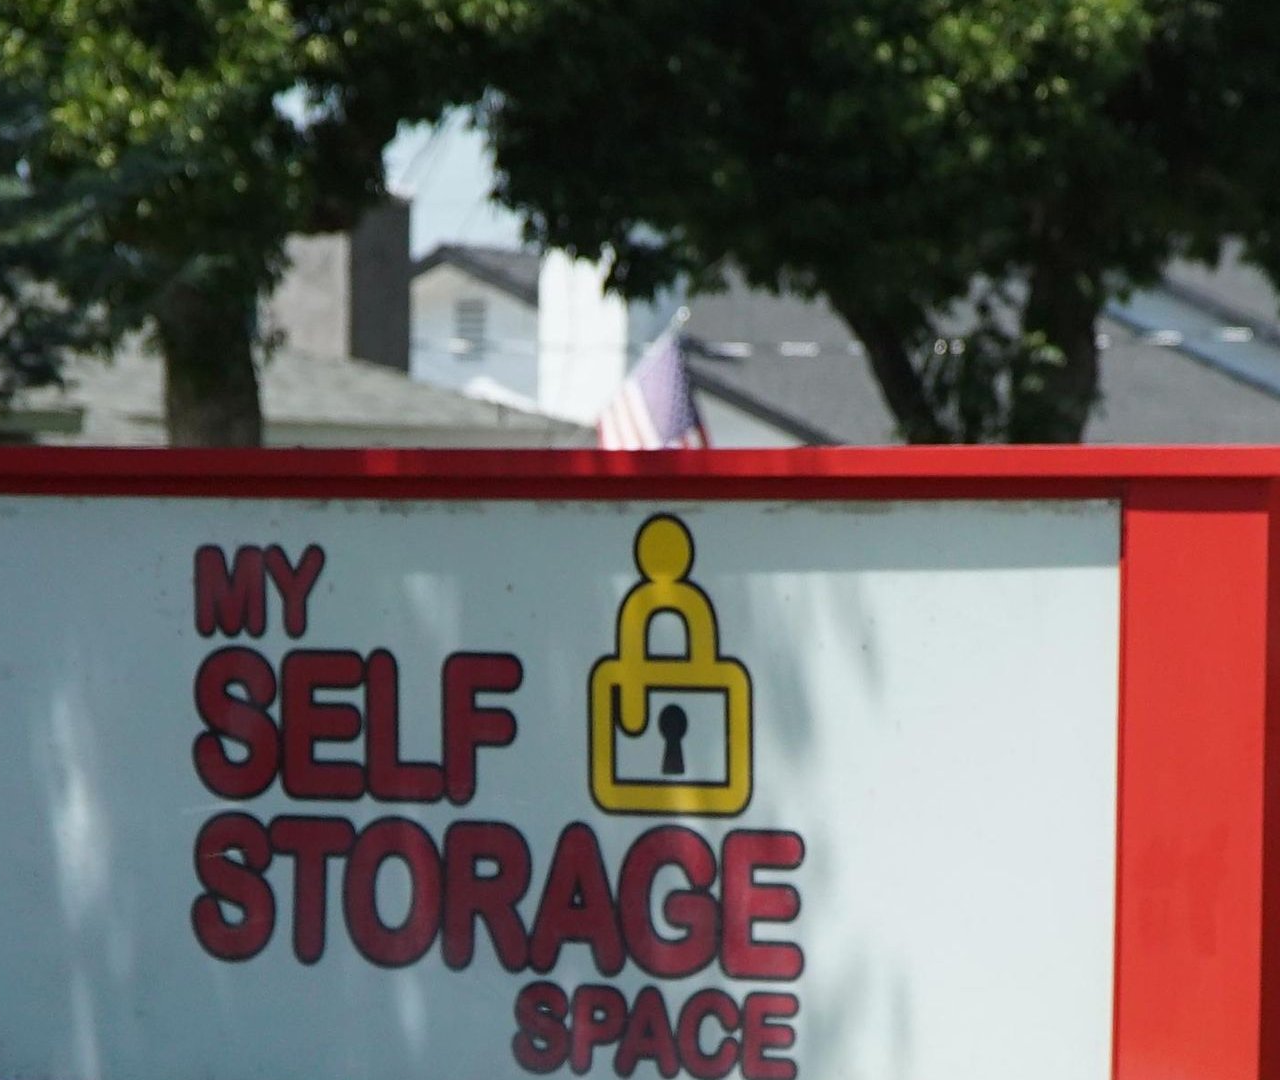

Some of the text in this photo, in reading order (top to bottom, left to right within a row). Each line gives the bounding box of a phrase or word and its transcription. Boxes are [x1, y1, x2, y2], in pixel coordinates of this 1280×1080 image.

[193, 543, 325, 639] MY
[191, 645, 524, 806] SELF
[191, 811, 805, 982] STORAGE
